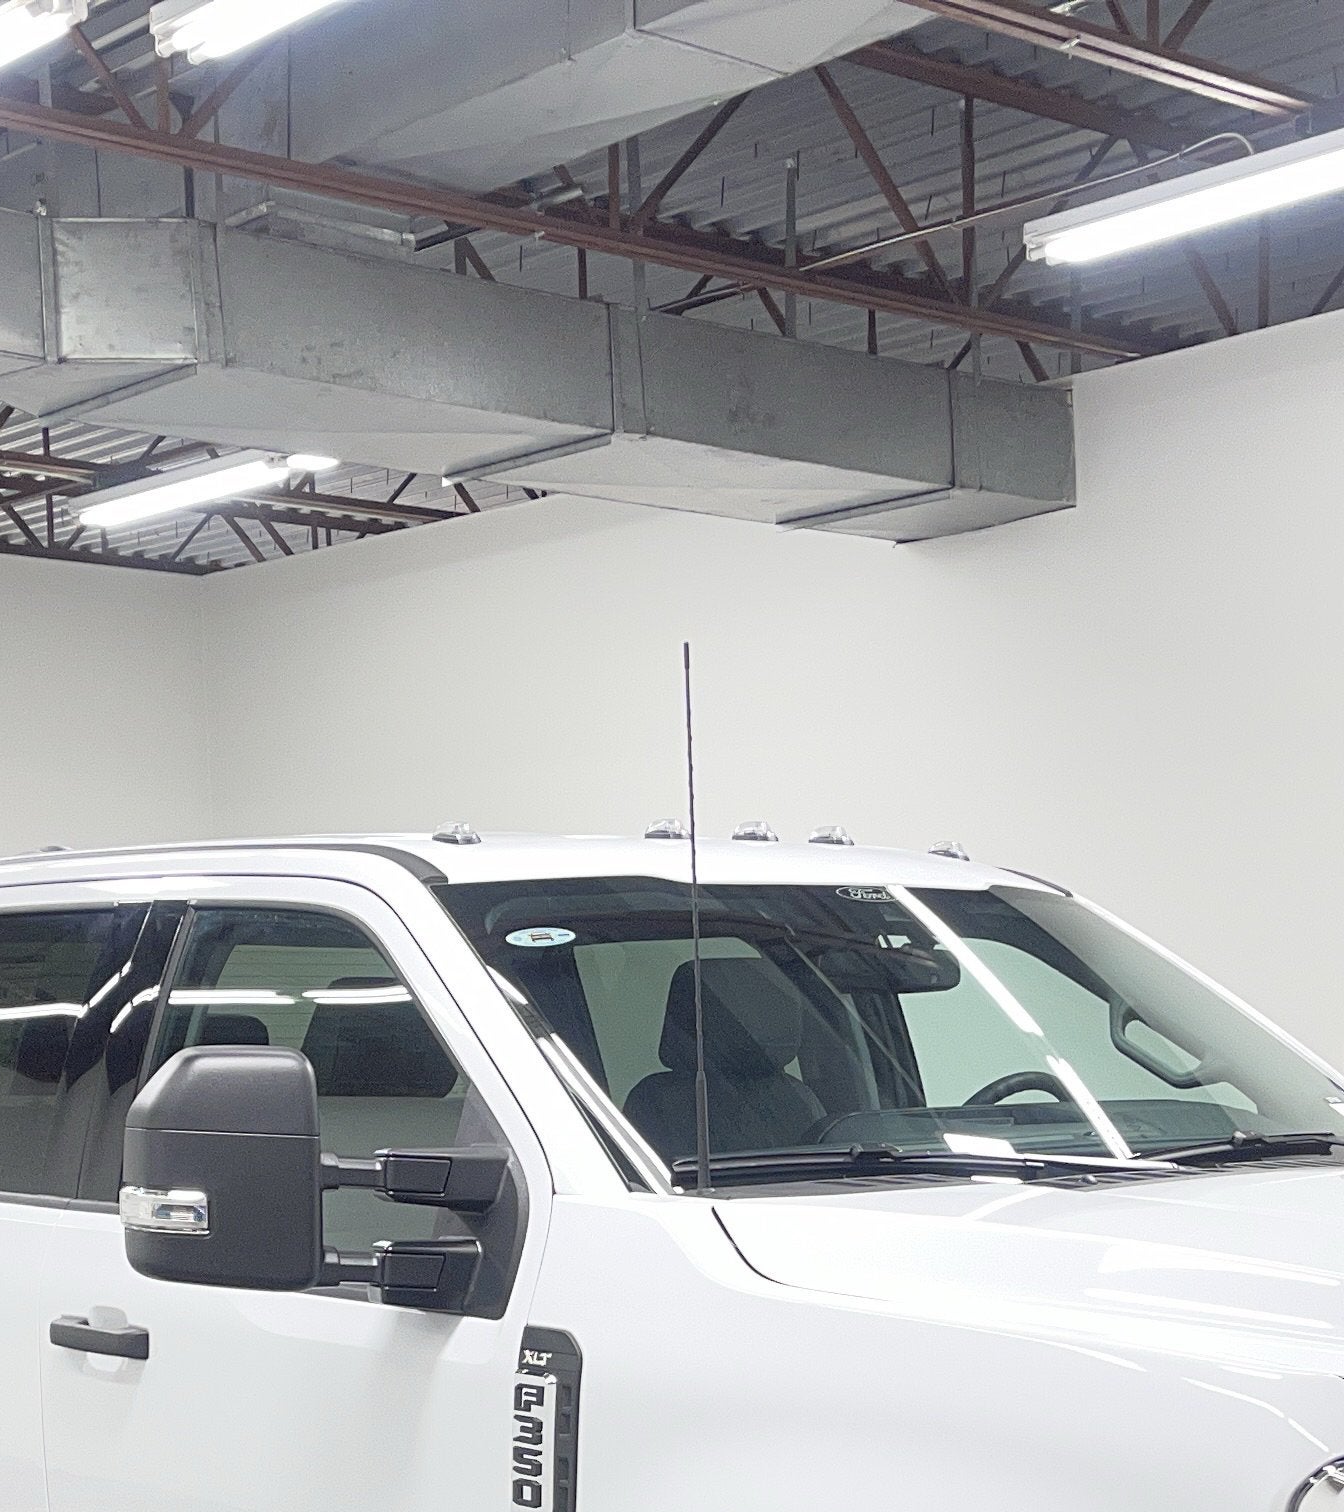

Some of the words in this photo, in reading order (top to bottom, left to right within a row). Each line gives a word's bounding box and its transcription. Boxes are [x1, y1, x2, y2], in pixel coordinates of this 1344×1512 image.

[848, 887, 891, 900] Ford
[521, 1349, 553, 1367] XLT
[512, 1382, 545, 1509] F350
